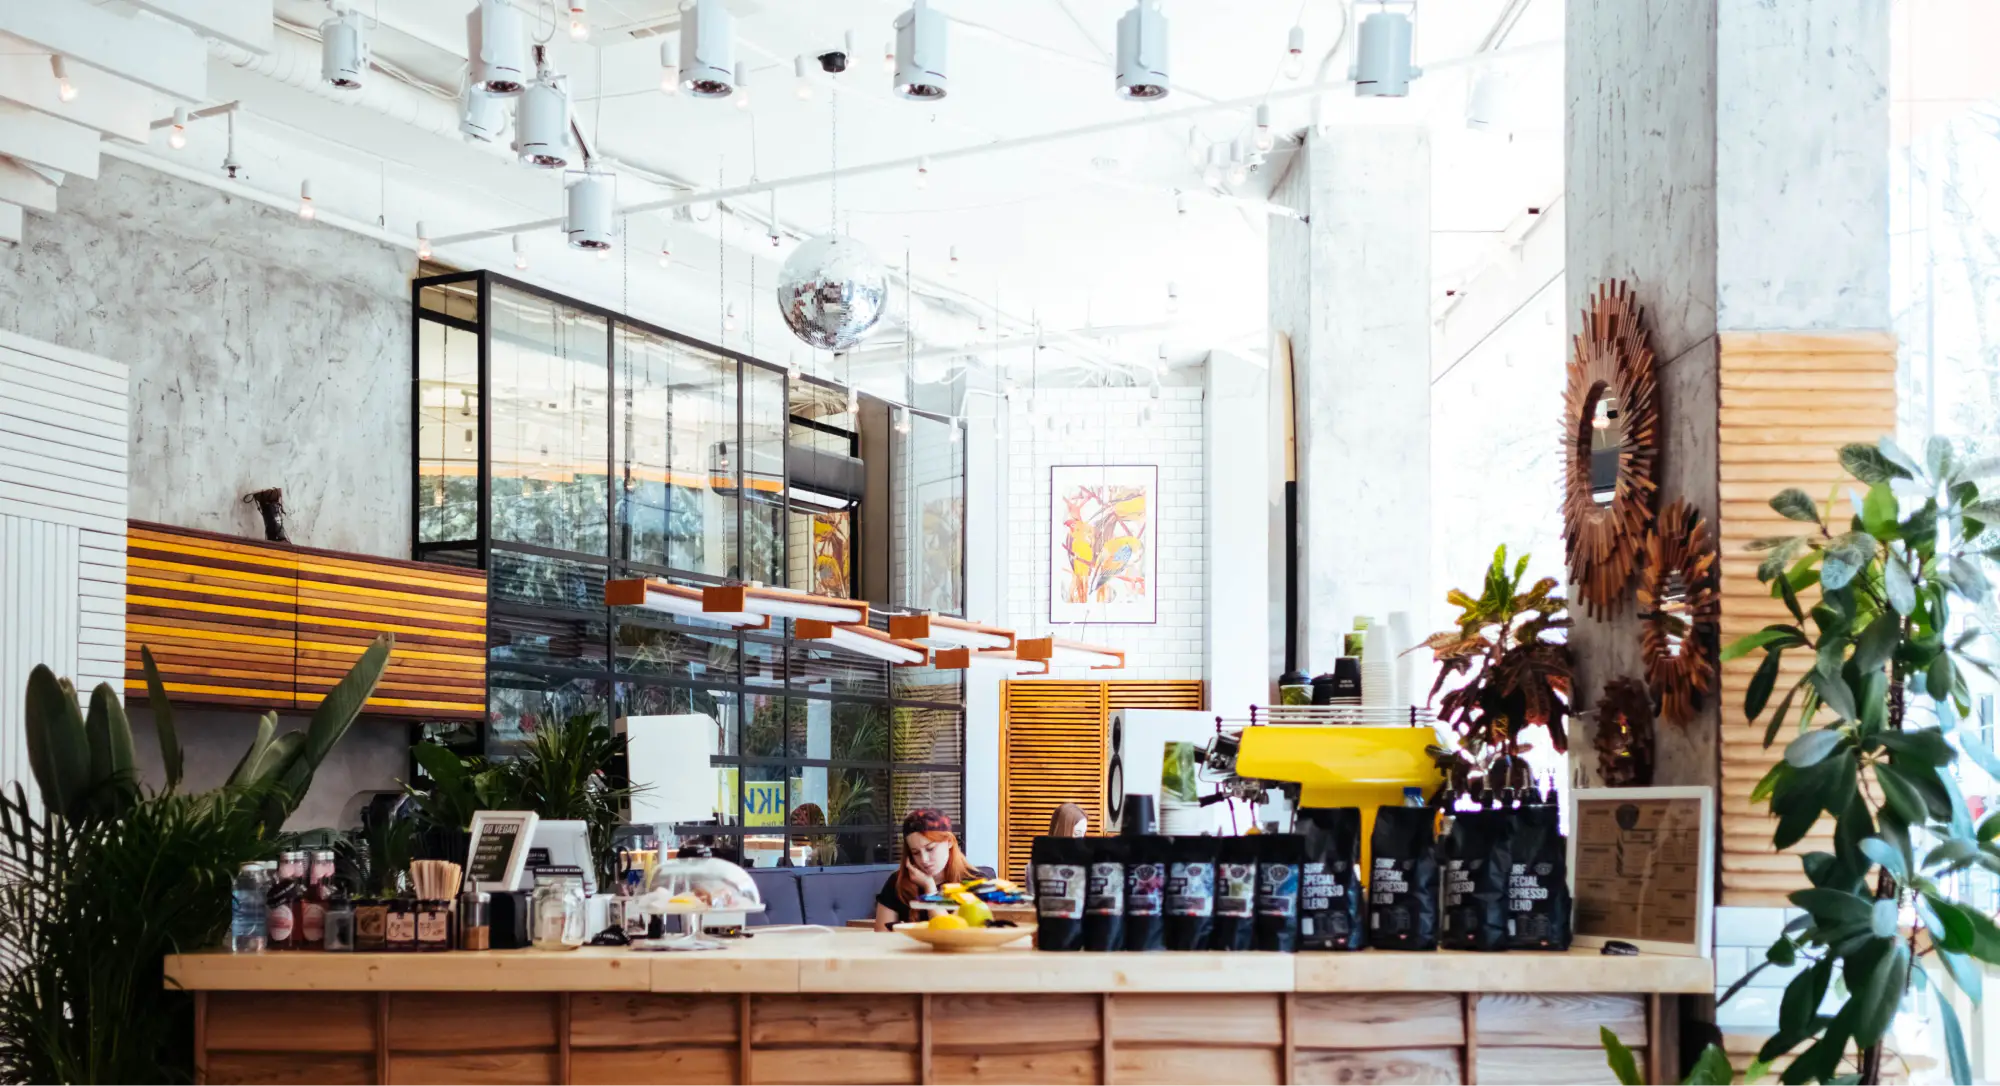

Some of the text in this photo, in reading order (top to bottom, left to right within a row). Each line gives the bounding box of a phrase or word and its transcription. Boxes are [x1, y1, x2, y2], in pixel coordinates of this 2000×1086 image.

[483, 824, 518, 834] GO VEGAN
[1374, 869, 1403, 881] SPECIAL
[1509, 875, 1540, 887] PECIAL
[1302, 885, 1344, 897] ESPRESSO
[1509, 888, 1549, 899] SPRESSO
[1509, 900, 1532, 911] LEND
